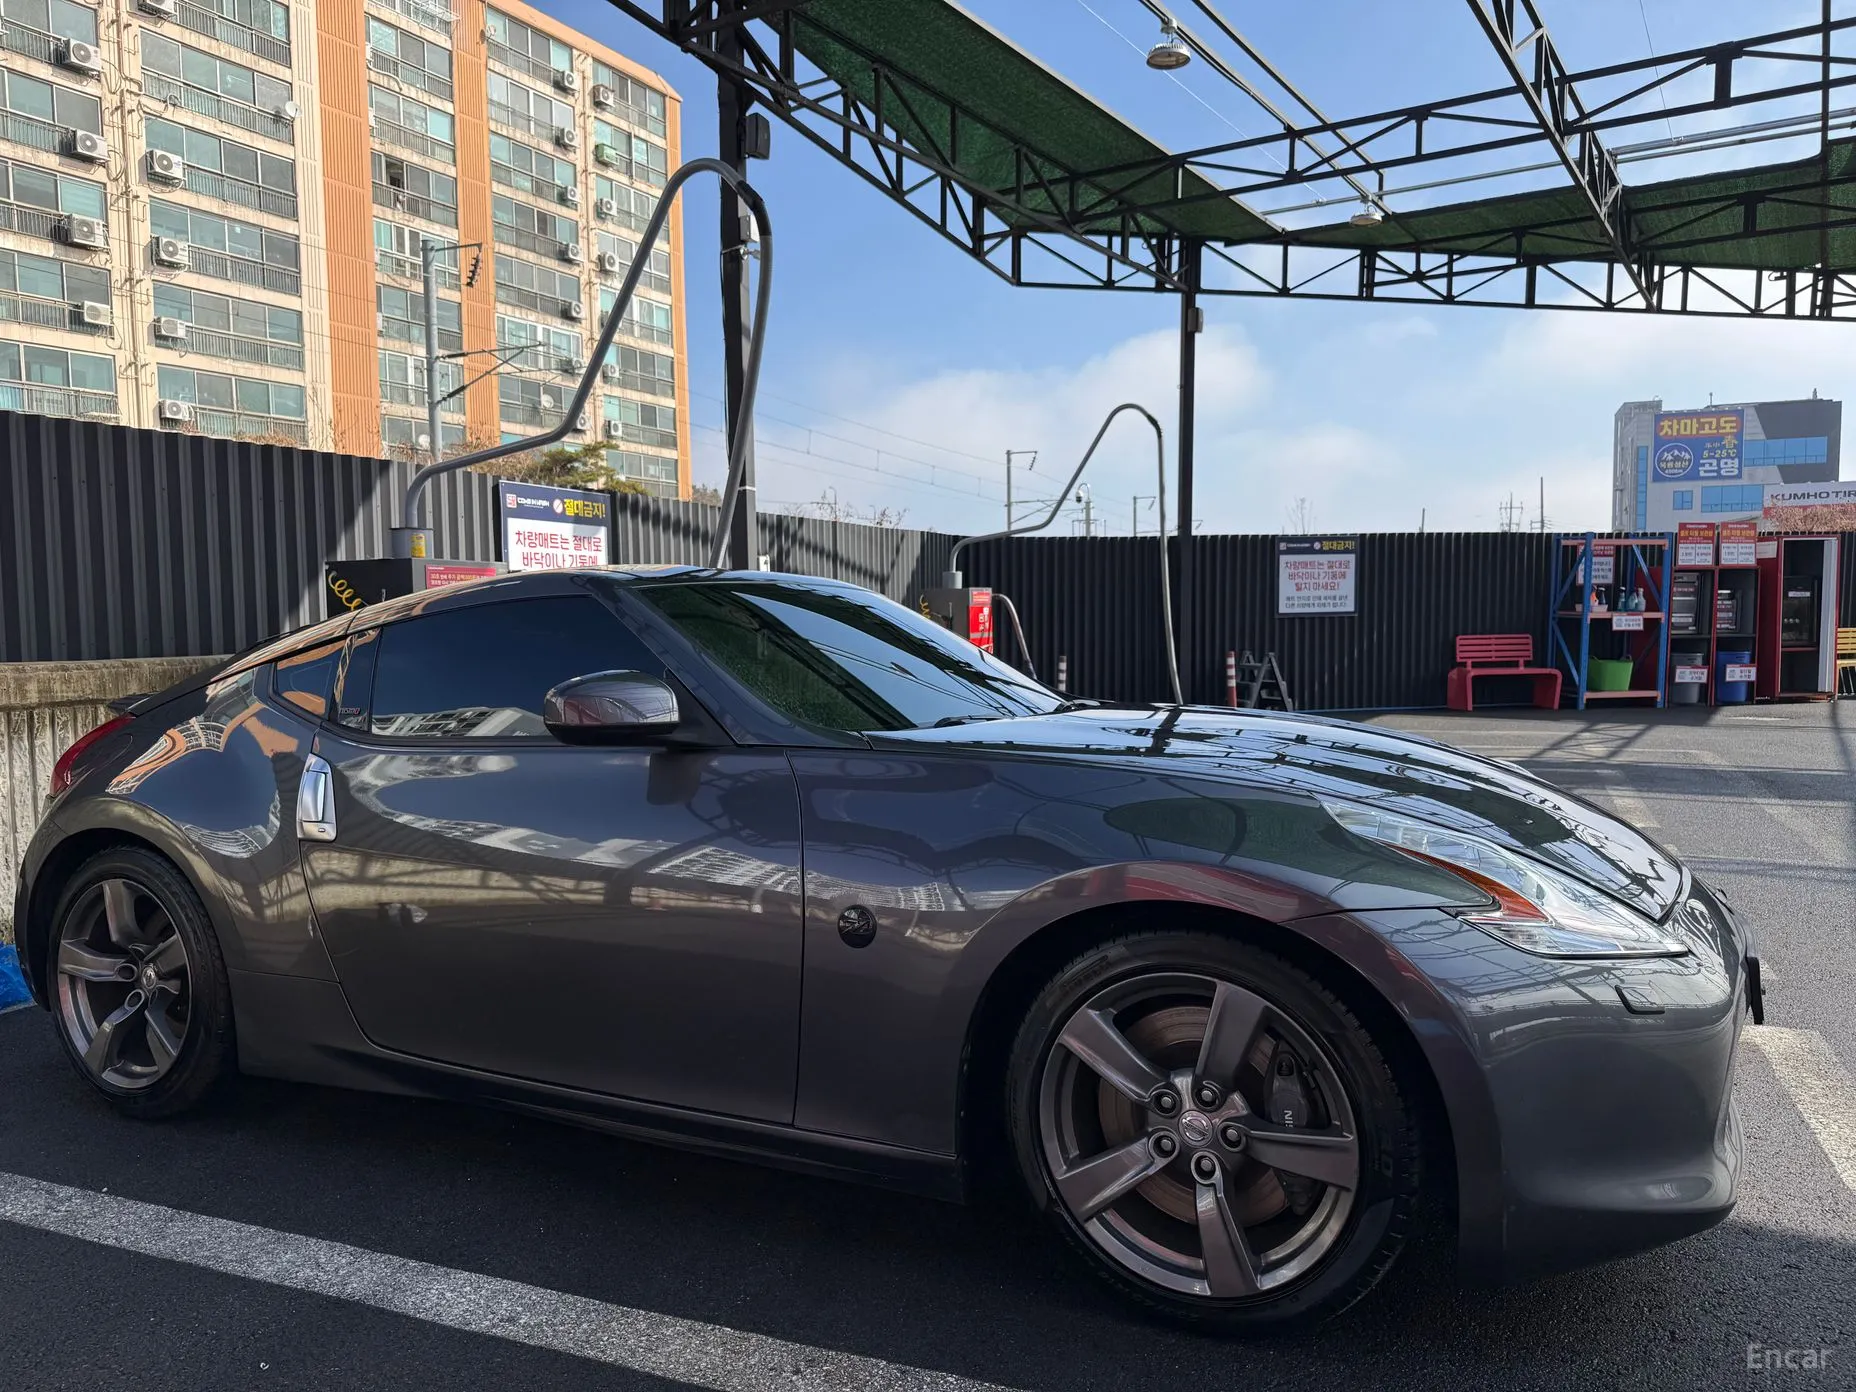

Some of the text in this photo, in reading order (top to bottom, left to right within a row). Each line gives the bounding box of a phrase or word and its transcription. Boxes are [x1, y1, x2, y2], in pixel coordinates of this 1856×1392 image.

[1660, 416, 1737, 436] 차마고도
[1770, 491, 1830, 501] KUMHO
[563, 498, 606, 519] 절대금지!
[515, 529, 602, 552] 차량매트는 절대로
[522, 551, 566, 569] 바닥이나
